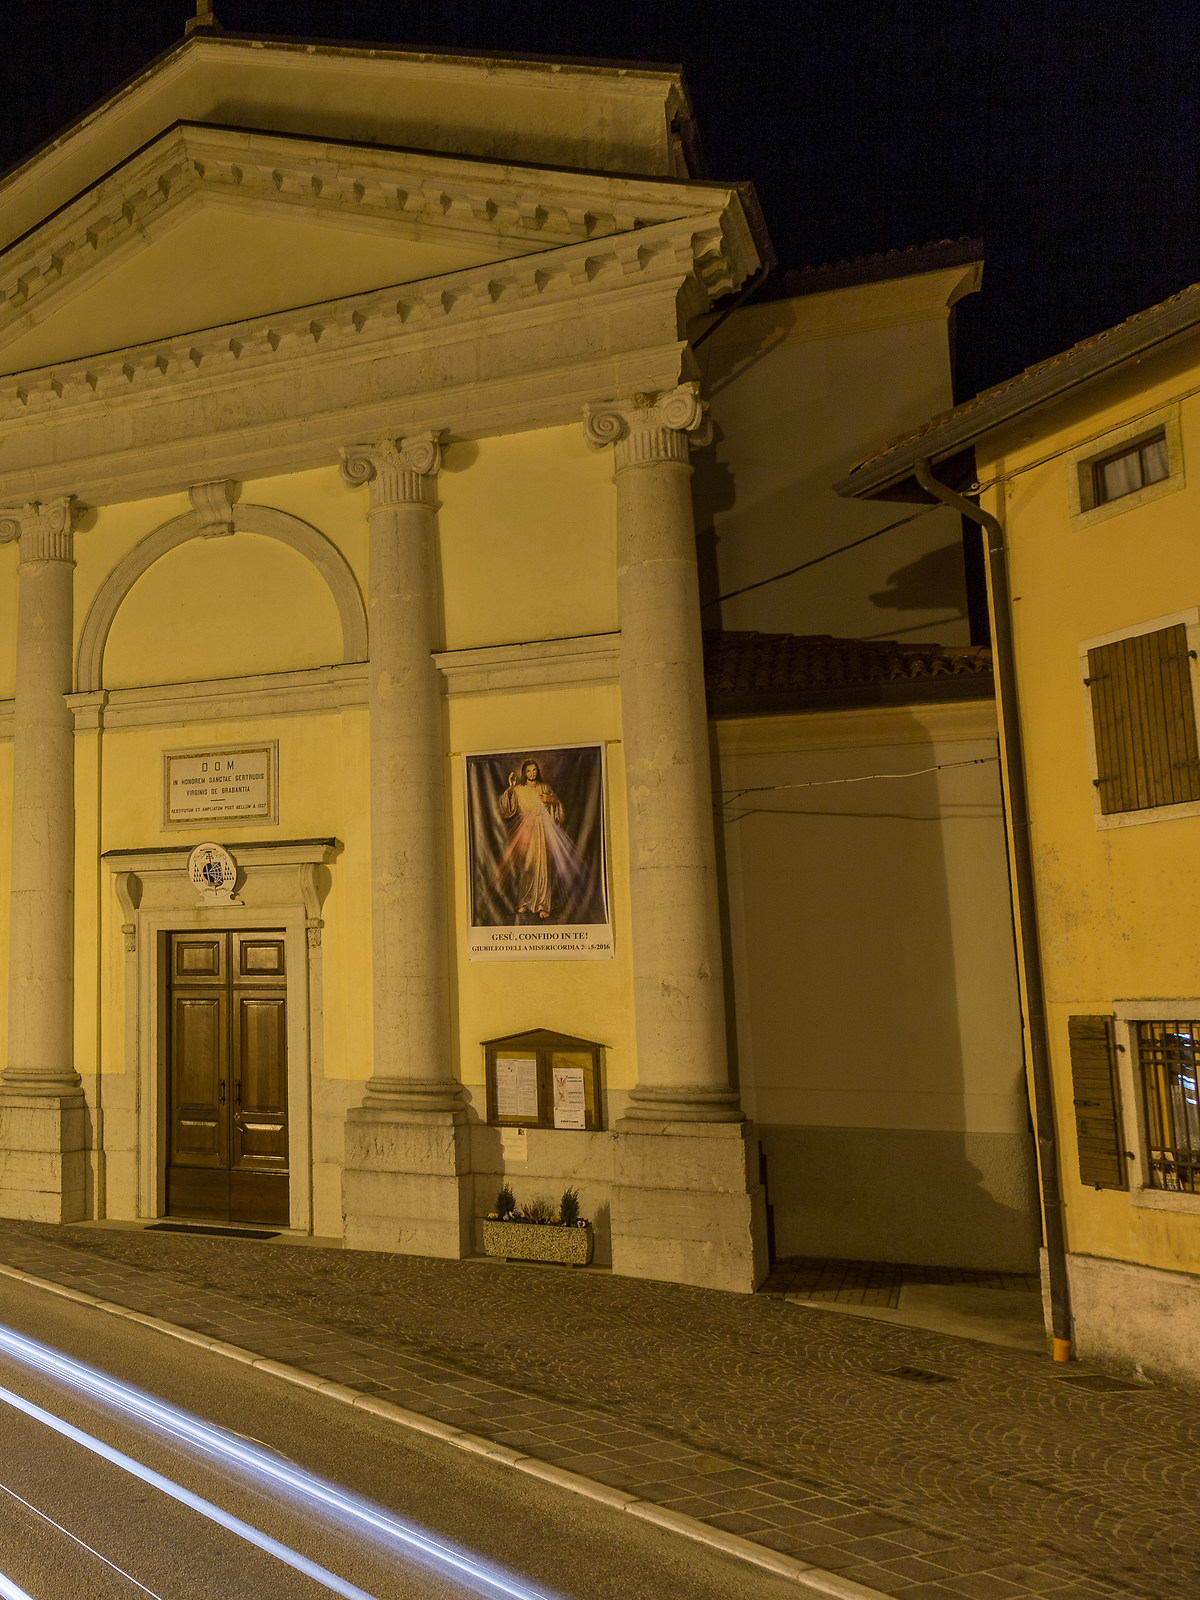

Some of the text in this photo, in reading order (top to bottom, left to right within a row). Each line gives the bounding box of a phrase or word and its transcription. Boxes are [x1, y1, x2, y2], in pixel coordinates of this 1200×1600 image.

[181, 777, 205, 785] HONOREM
[208, 775, 232, 783] SANCTAE
[235, 773, 265, 781] GERTRUDIS
[186, 786, 250, 796] VIRGINIS DE BRABANTIA
[518, 932, 559, 941] CONFIDO
[561, 932, 571, 940] IN
[572, 932, 588, 940] TE!
